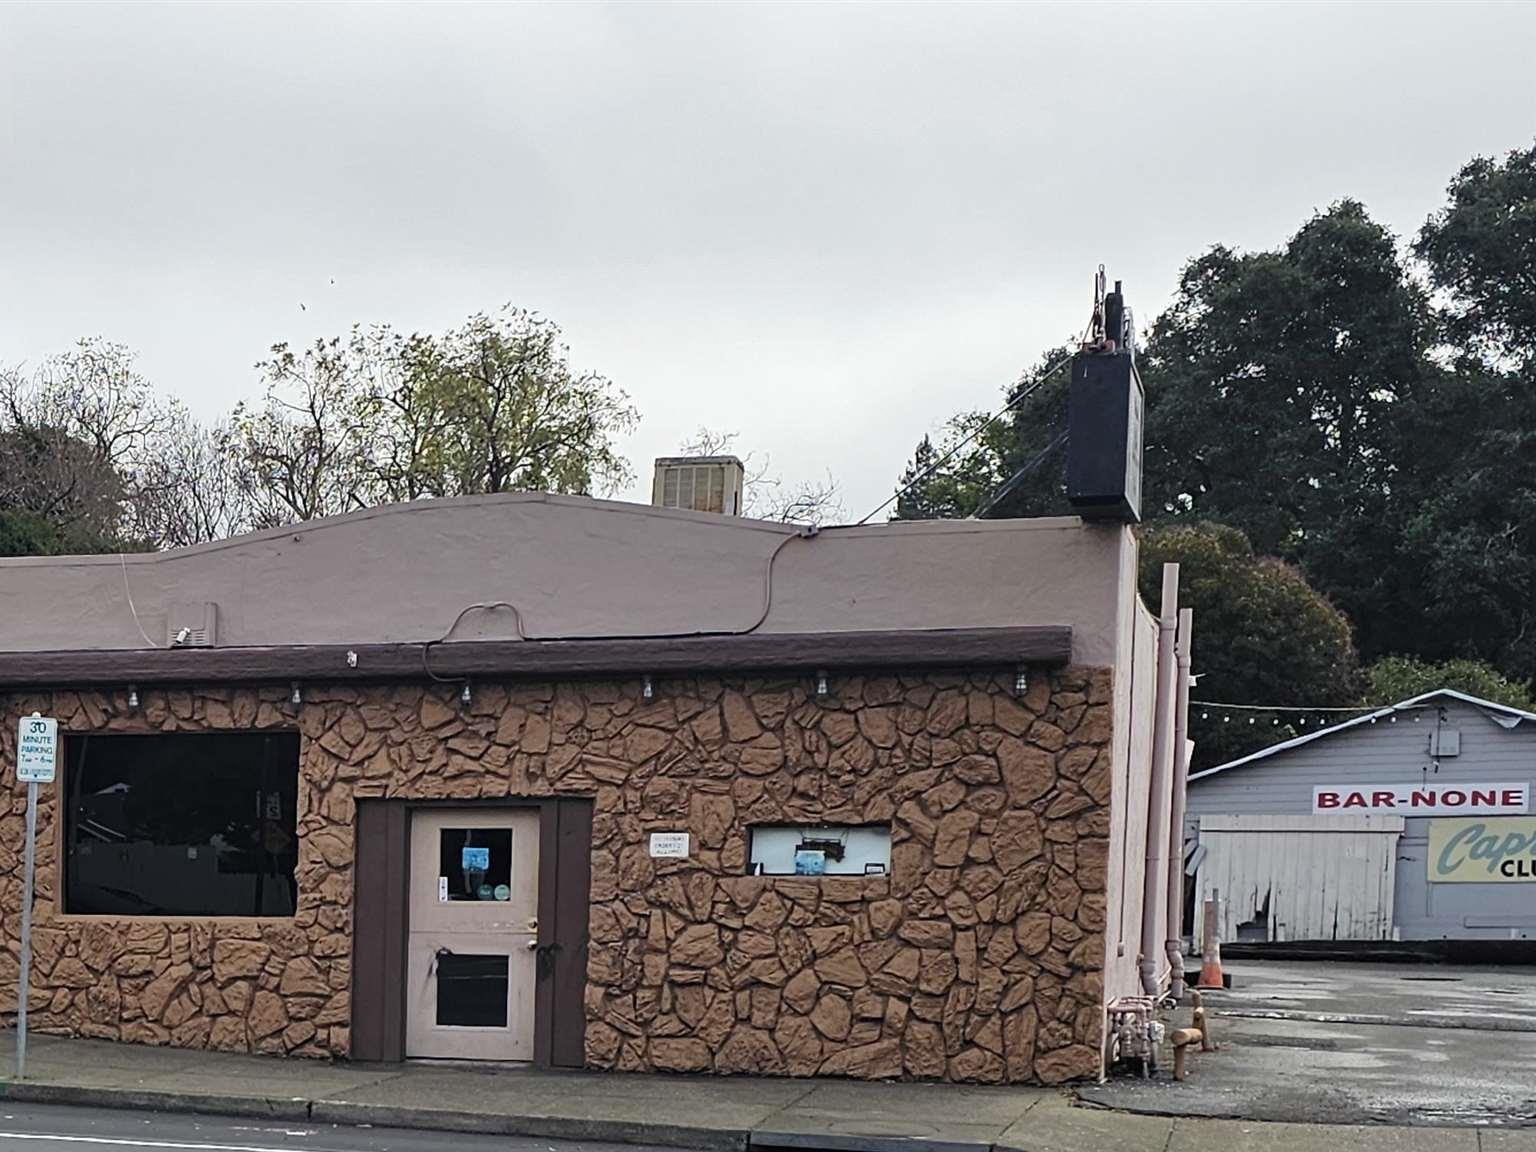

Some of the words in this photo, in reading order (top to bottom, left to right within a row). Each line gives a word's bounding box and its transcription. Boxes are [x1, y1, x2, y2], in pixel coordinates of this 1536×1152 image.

[30, 721, 47, 734] 30
[22, 735, 53, 744] MINUTE
[20, 746, 53, 755] PARKING
[1317, 790, 1524, 809] BAR-NONE
